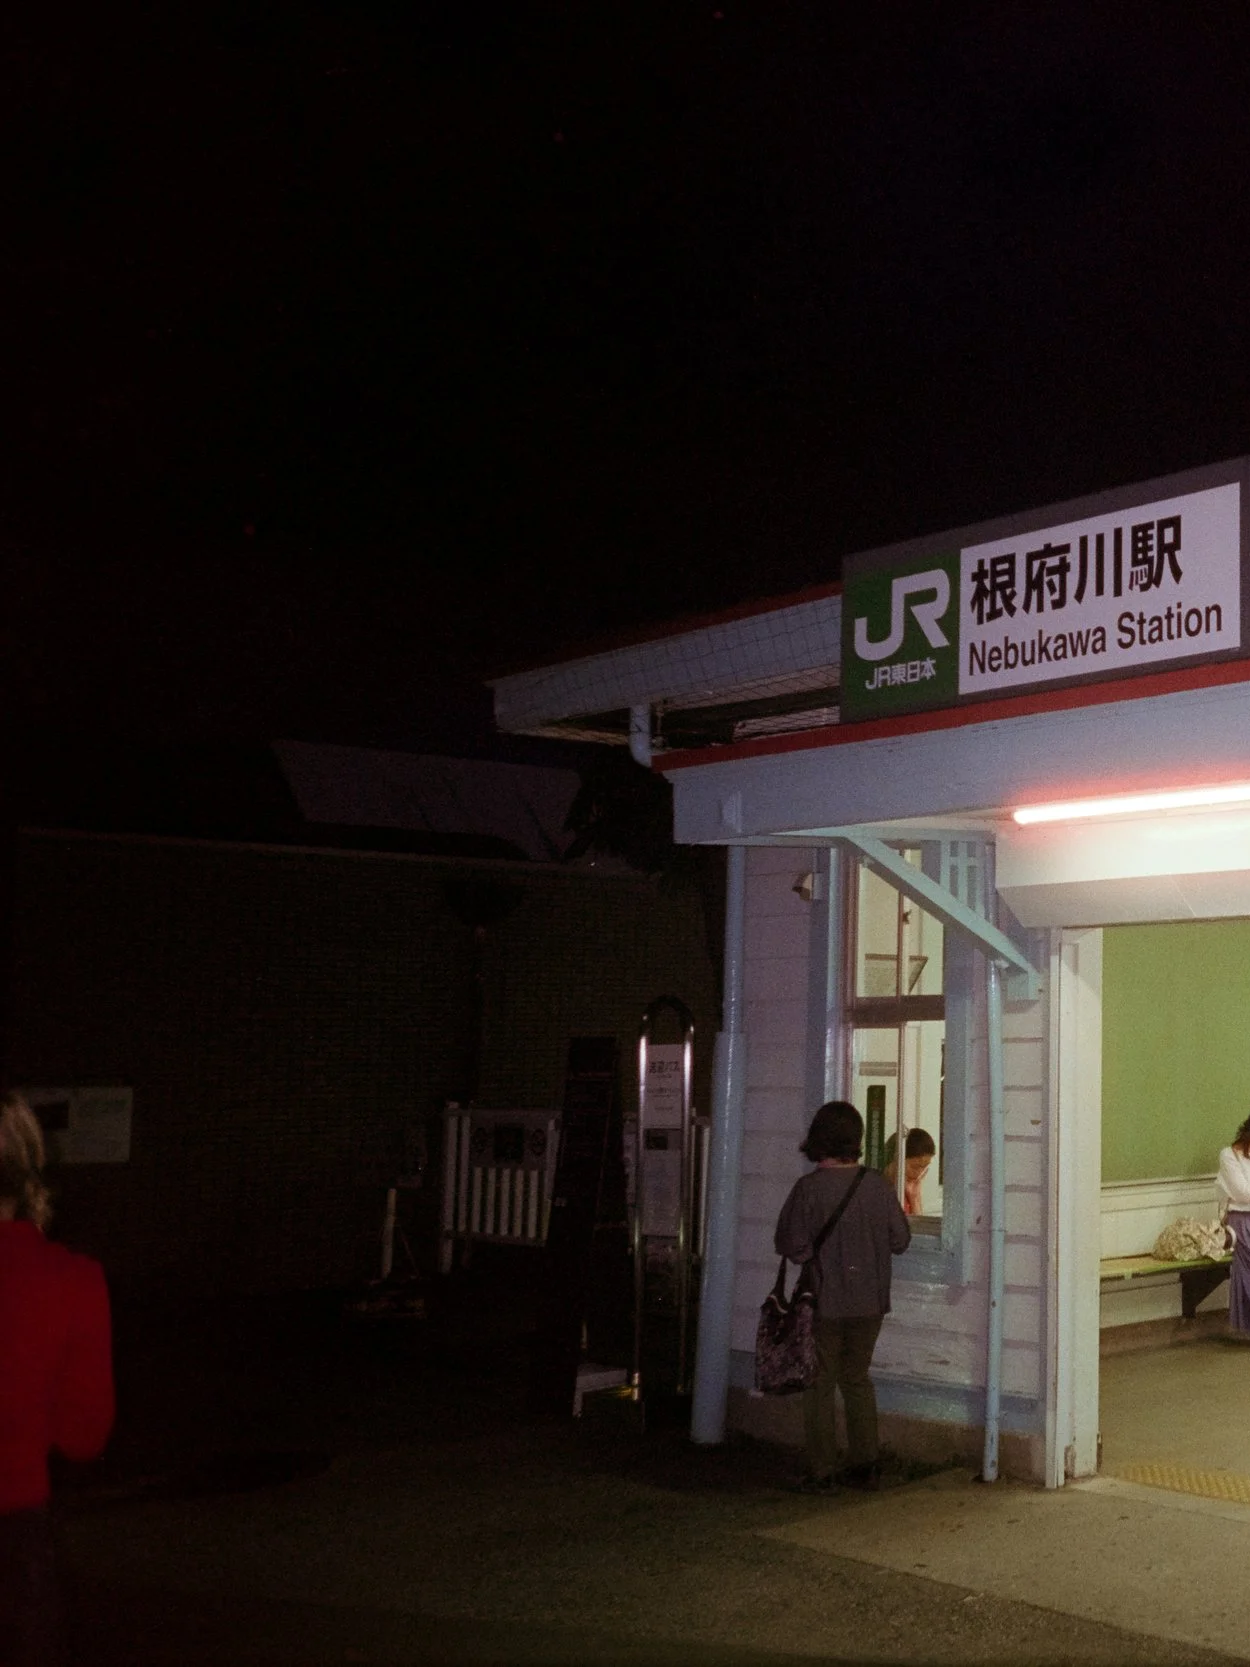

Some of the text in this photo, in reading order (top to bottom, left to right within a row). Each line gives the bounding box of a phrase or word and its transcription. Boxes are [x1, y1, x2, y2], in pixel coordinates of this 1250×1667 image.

[969, 514, 1184, 626] 根府川駅
[854, 568, 951, 661] JR
[968, 602, 1223, 676] Nebukawa Station
[865, 658, 937, 691] JR東日本
